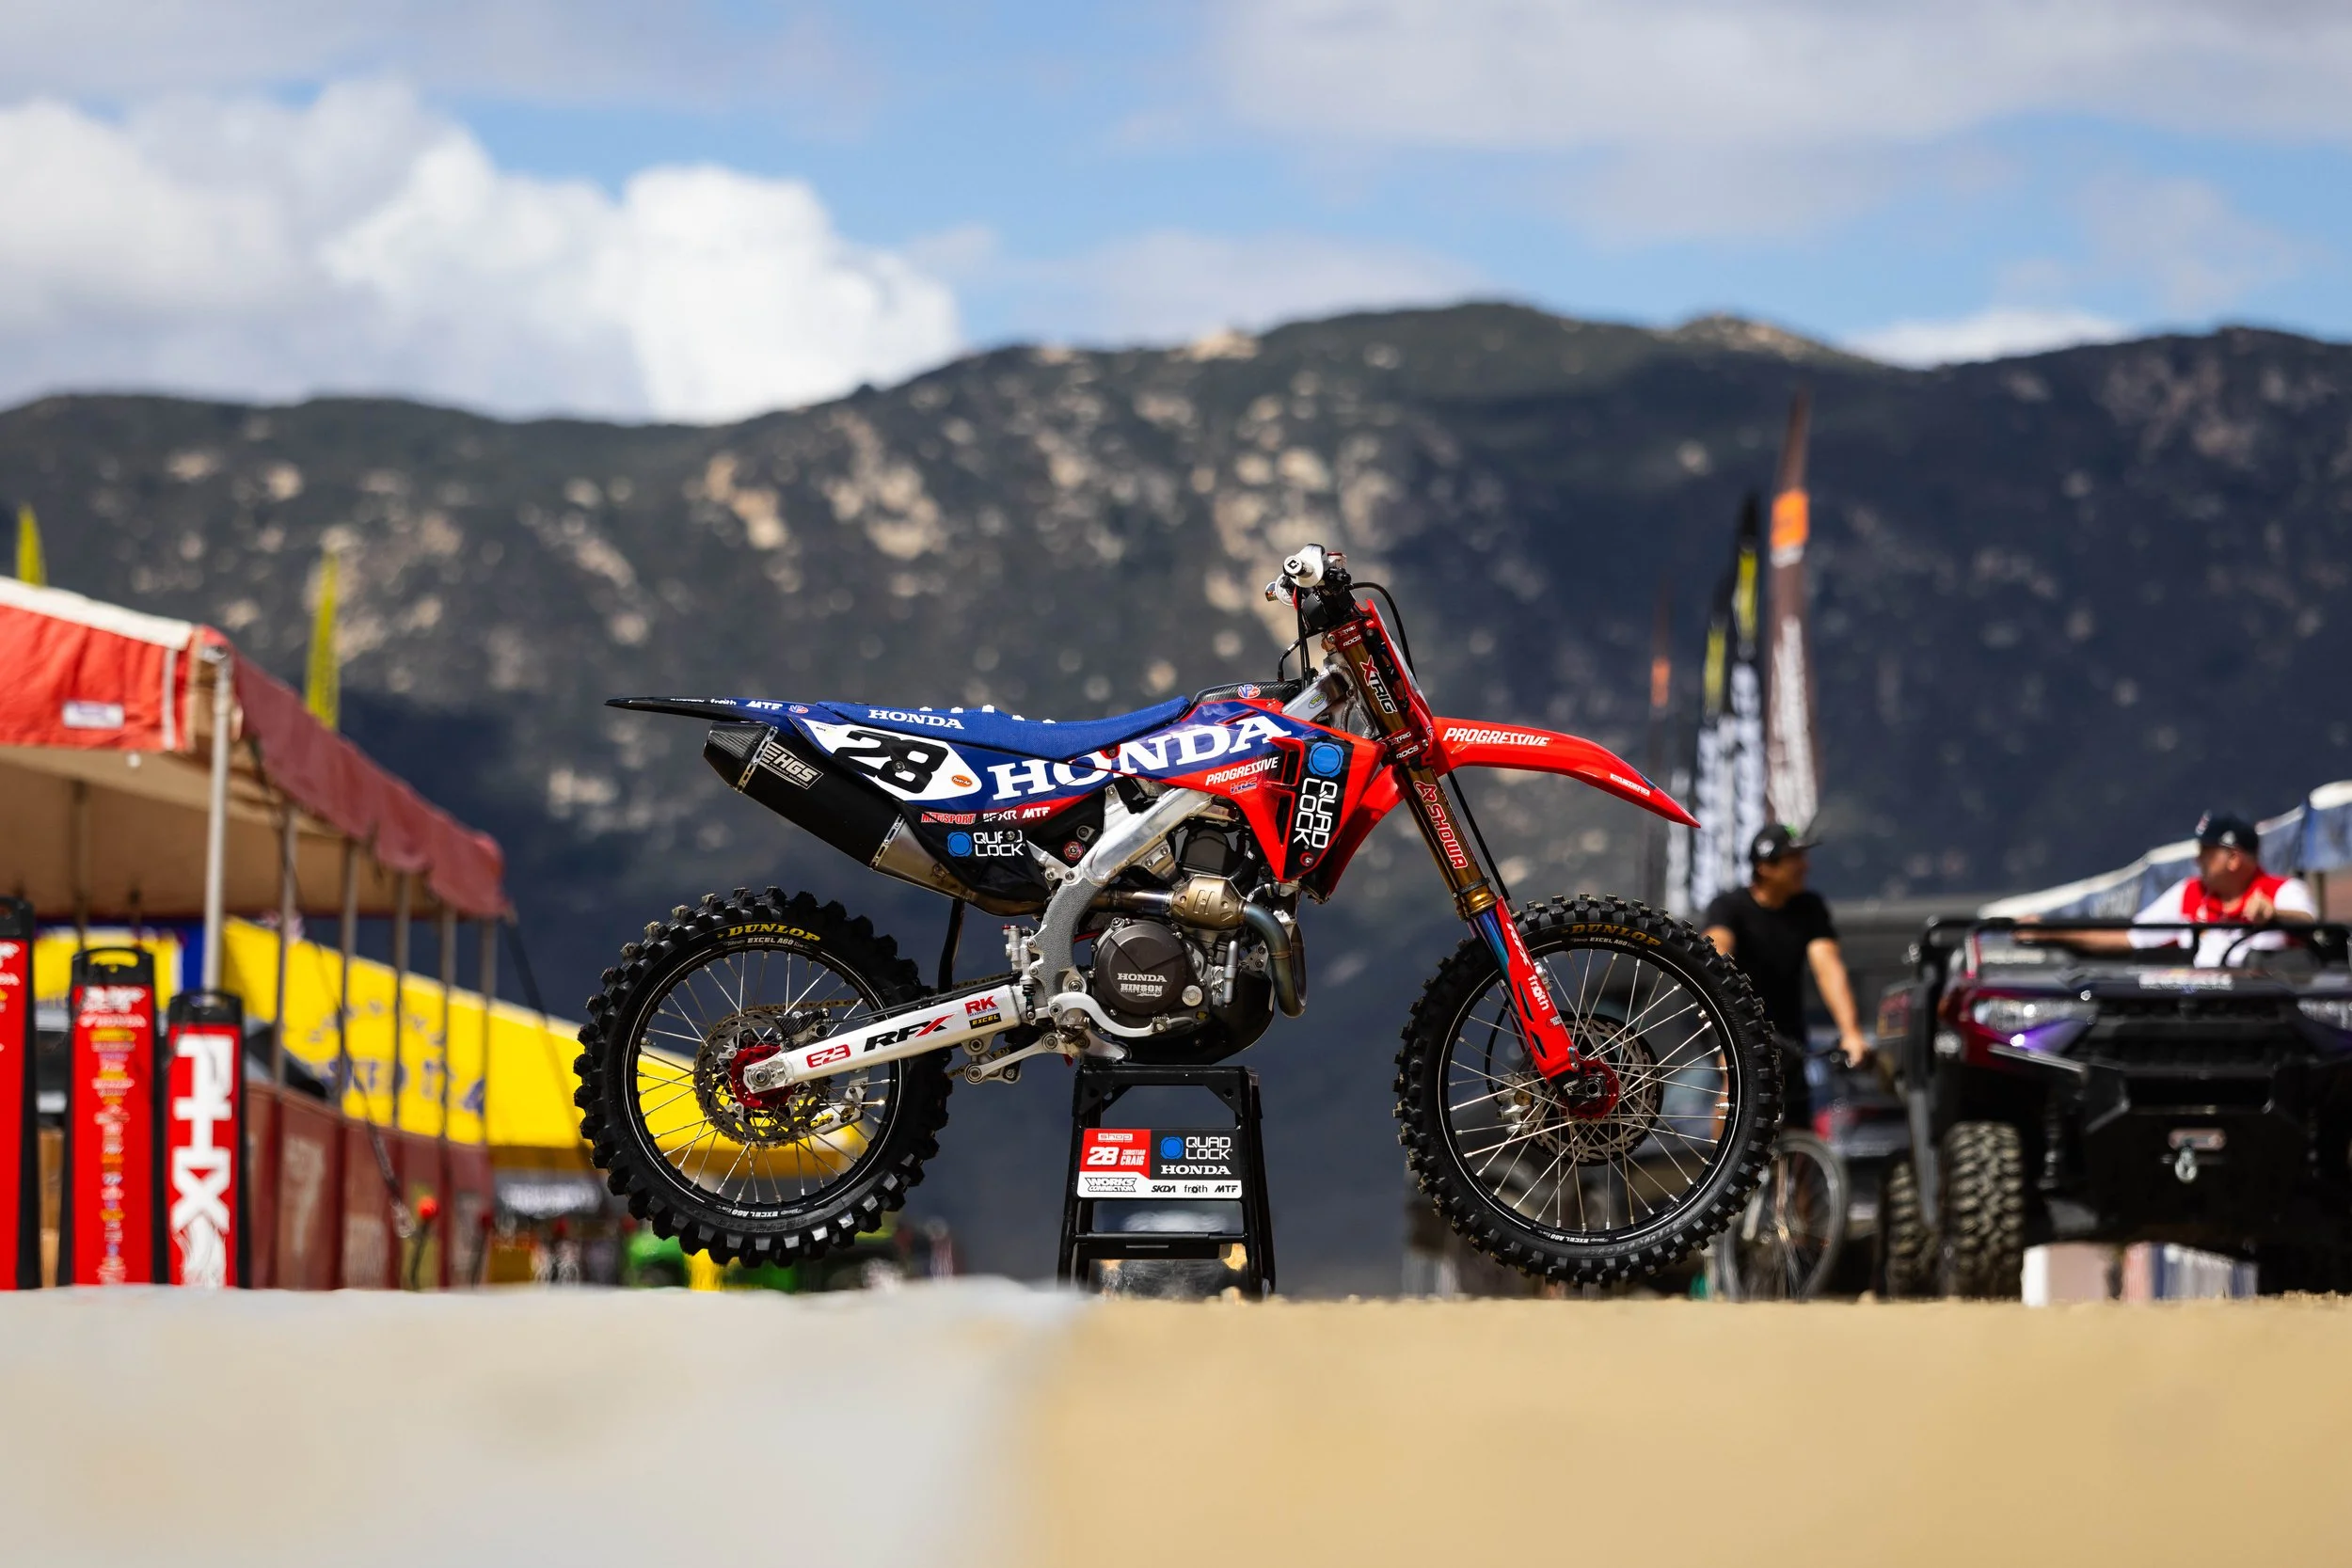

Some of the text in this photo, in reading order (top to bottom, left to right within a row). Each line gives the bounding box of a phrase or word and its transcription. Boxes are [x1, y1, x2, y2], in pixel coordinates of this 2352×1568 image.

[1359, 655, 1397, 714] XTRIG
[746, 701, 783, 710] MTF
[868, 709, 964, 730] HONDA
[1442, 727, 1550, 746] PROGRESSIVE
[988, 716, 1291, 800] HONDA
[1396, 745, 1419, 759] ROCS
[773, 753, 818, 782] HGS
[832, 730, 948, 794] 28
[1205, 756, 1279, 786] PROGRESSIVE
[1022, 807, 1050, 818] MTF
[1294, 778, 1321, 846] LOCK
[1311, 781, 1338, 848] QUAD
[1426, 803, 1468, 868] SHOWA
[976, 844, 1024, 857] LOCK
[727, 924, 820, 941] DUNLOP
[1570, 924, 1661, 946] DUNLOP
[1117, 973, 1167, 983] HONDA
[1120, 983, 1163, 992] HINSON
[964, 995, 999, 1015] RK
[972, 1015, 999, 1025] EXCEL
[864, 1012, 956, 1053] RFX
[1185, 1136, 1231, 1148] QUAD
[1087, 1147, 1120, 1165] 28
[1120, 1155, 1145, 1165] CRAIG
[1185, 1148, 1231, 1160] LOCK
[1161, 1165, 1232, 1175] HONDA
[1085, 1178, 1137, 1186] WORKS
